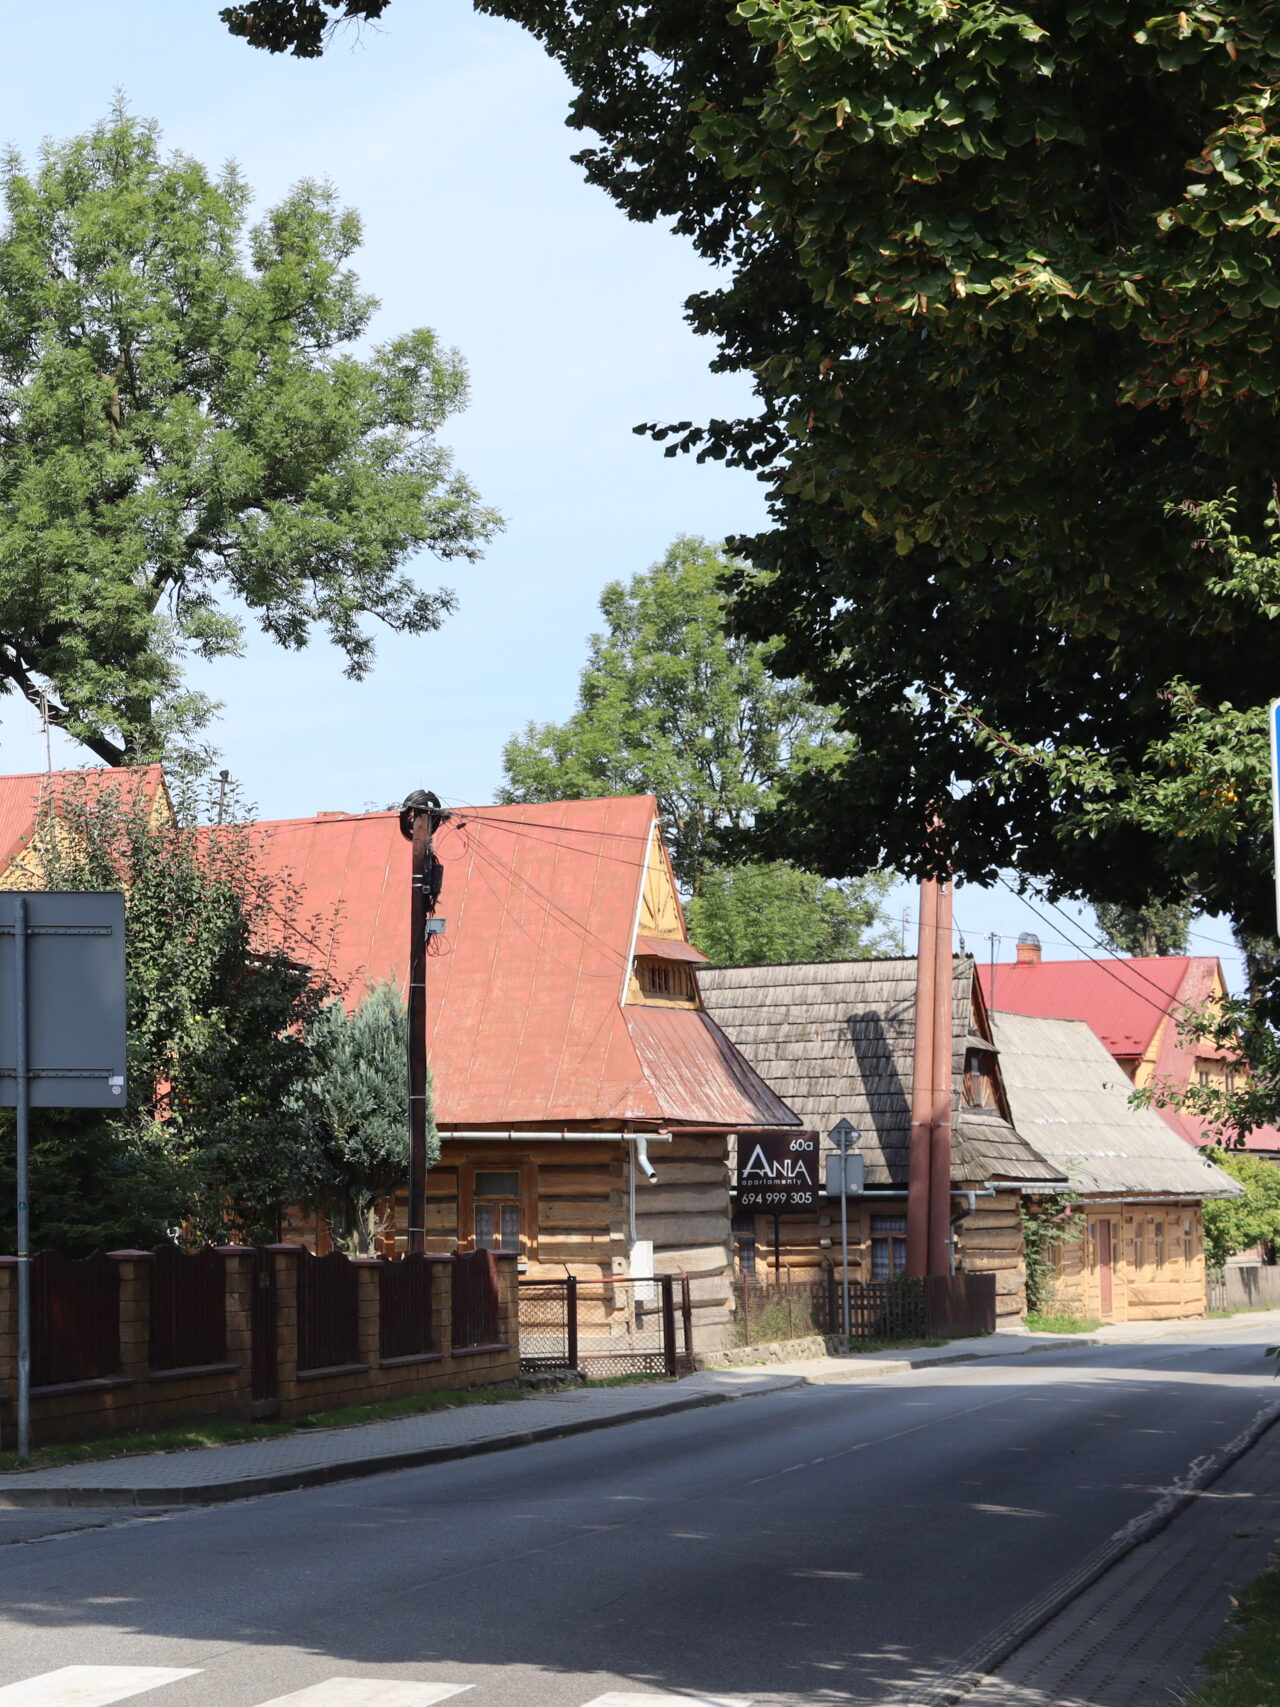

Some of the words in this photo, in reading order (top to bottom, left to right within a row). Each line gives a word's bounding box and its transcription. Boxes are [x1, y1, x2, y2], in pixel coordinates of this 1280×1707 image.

[789, 1139, 813, 1151] 60a
[742, 1143, 812, 1186] ANIA
[741, 1178, 802, 1186] apartamenty
[741, 1193, 763, 1204] 694
[765, 1192, 787, 1204] 999
[790, 1192, 812, 1204] 305
